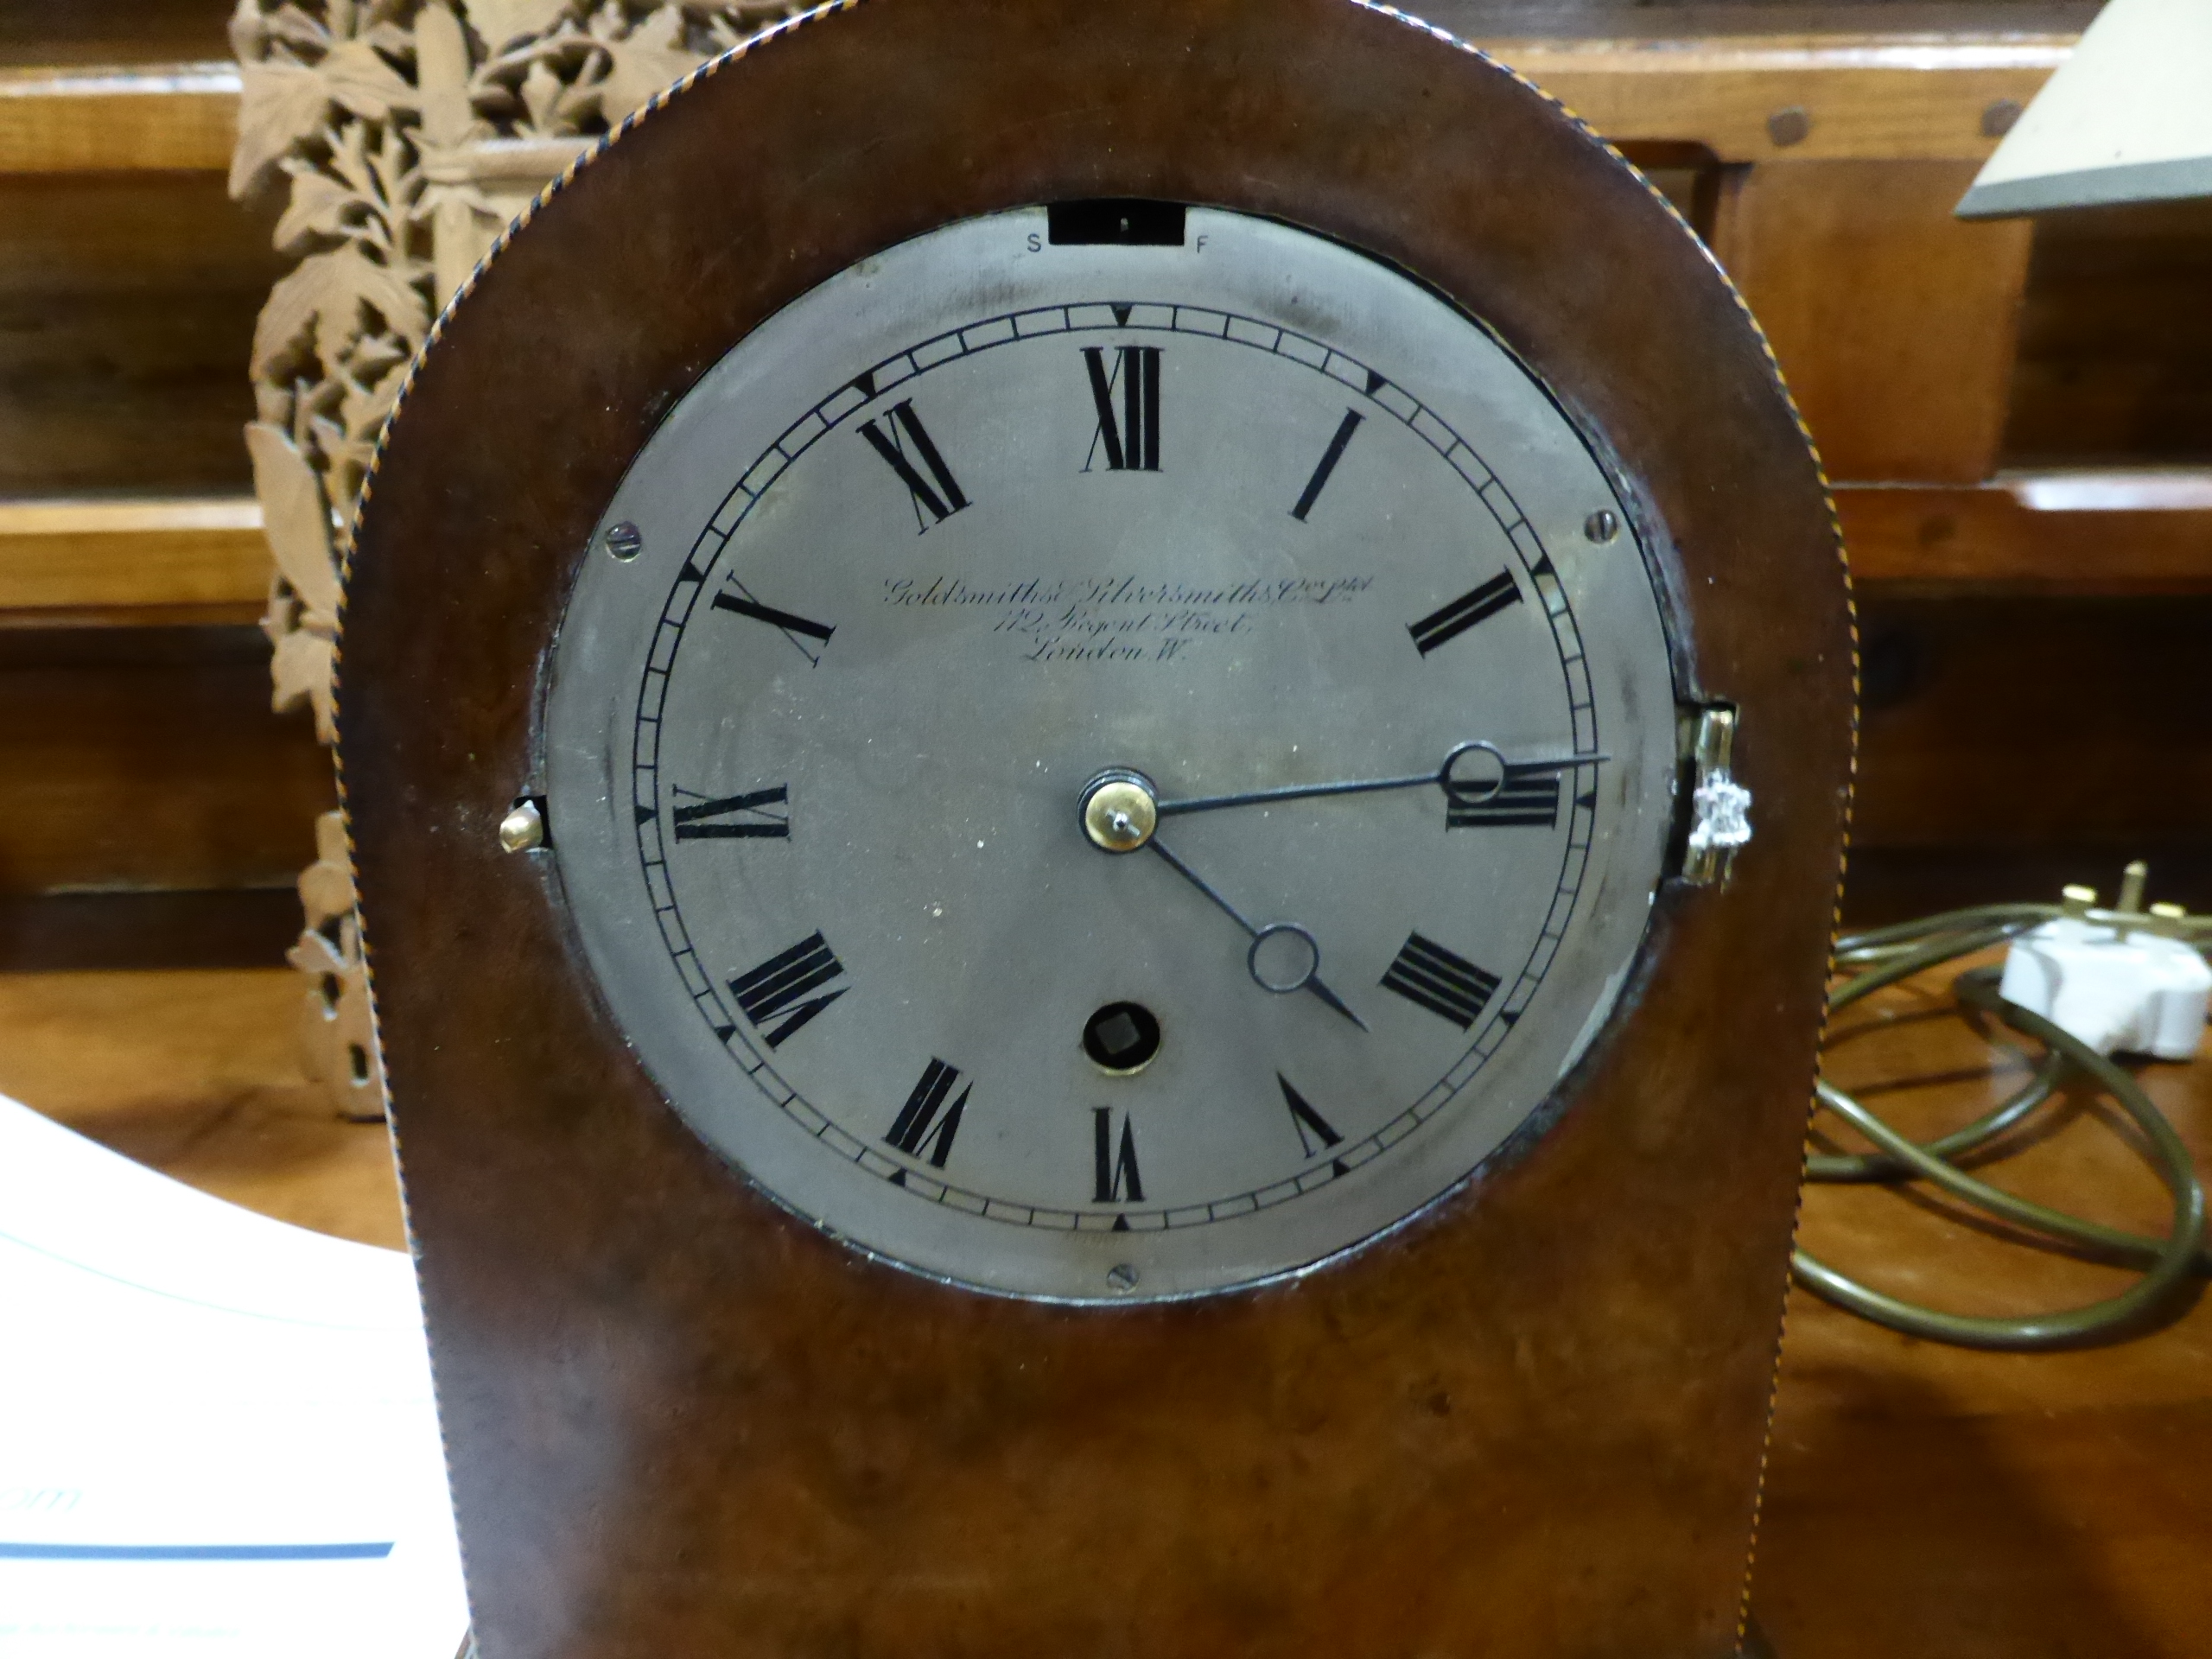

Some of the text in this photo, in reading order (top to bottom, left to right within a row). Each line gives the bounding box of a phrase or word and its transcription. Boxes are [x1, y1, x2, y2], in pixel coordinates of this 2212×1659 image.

[1027, 233, 1042, 253] S
[1196, 235, 1209, 253] F
[1079, 345, 1165, 473] XII
[856, 398, 972, 535] XI
[1287, 406, 1366, 524] I
[711, 570, 836, 668] X
[1406, 565, 1523, 659] II
[672, 783, 790, 843] IX
[726, 929, 850, 1052] VIII
[881, 1056, 974, 1170] VII
[1092, 1106, 1145, 1203] VI
[1276, 1071, 1344, 1159] V
